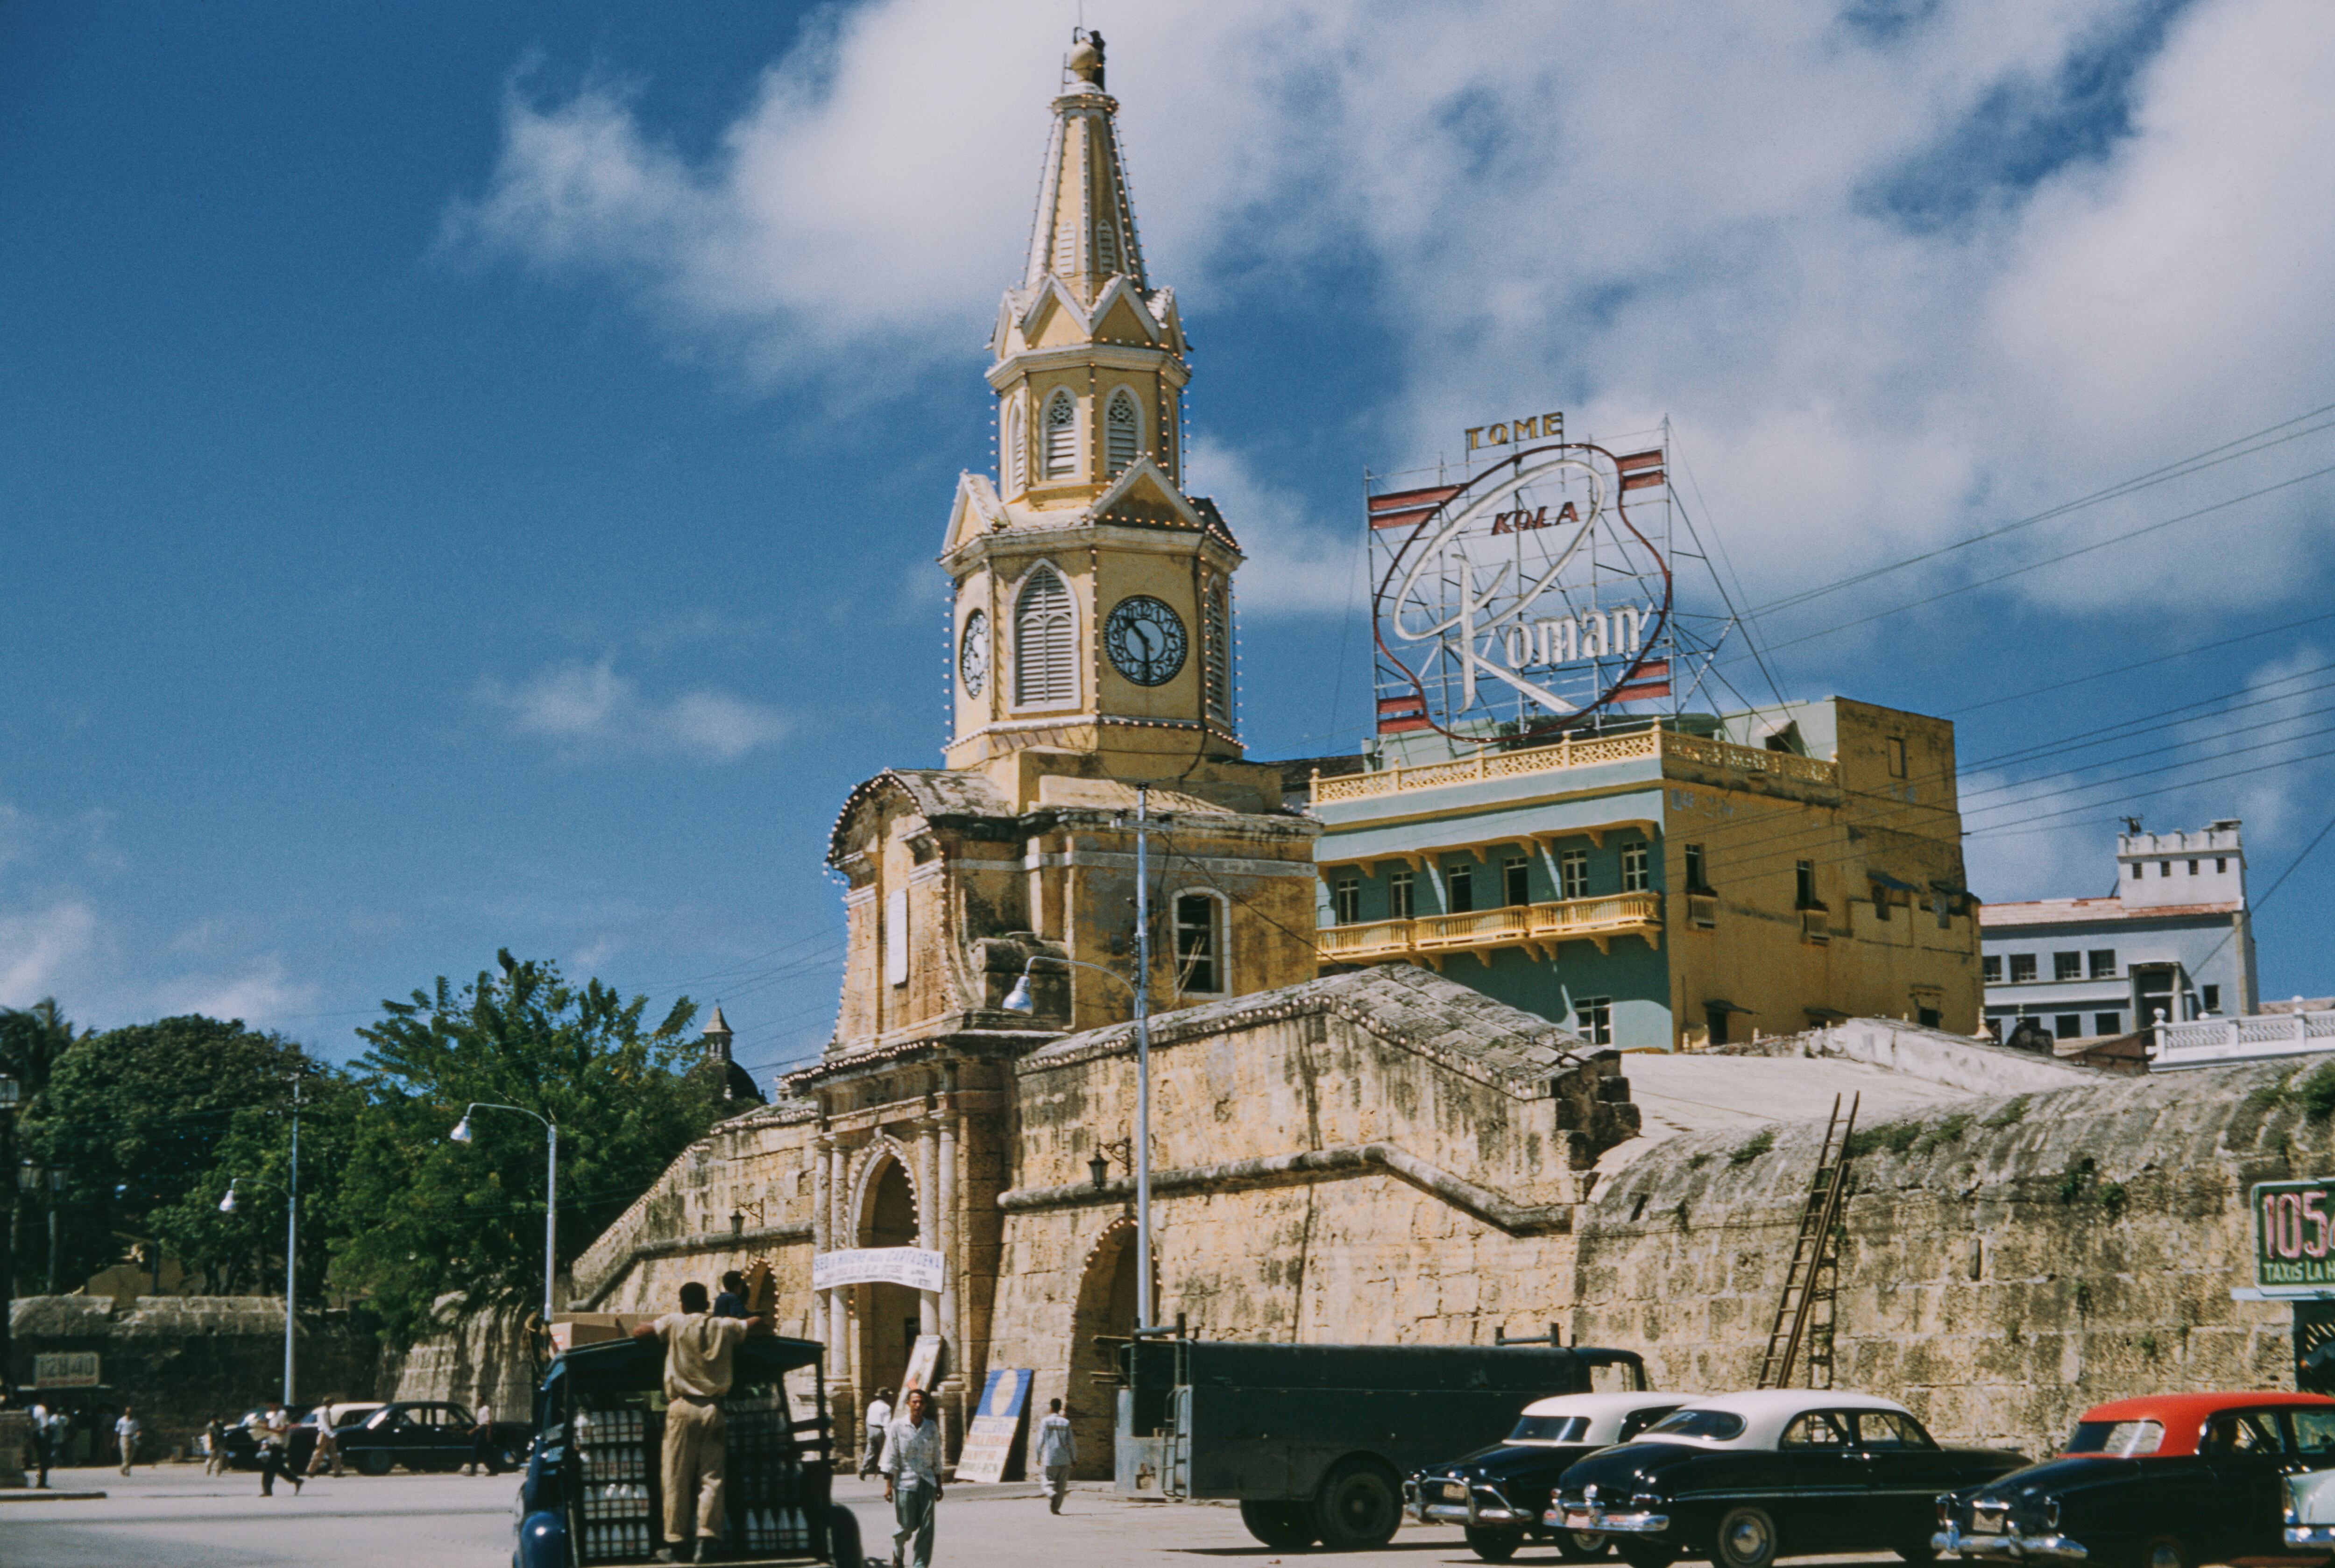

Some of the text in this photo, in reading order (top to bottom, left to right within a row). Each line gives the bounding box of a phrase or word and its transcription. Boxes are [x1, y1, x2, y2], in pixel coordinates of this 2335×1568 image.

[1465, 412, 1563, 450] TOME
[1491, 501, 1579, 535] KOLA
[2263, 1191, 2335, 1258] 105
[2264, 1263, 2302, 1281] TAXIS
[2306, 1261, 2324, 1280] LA
